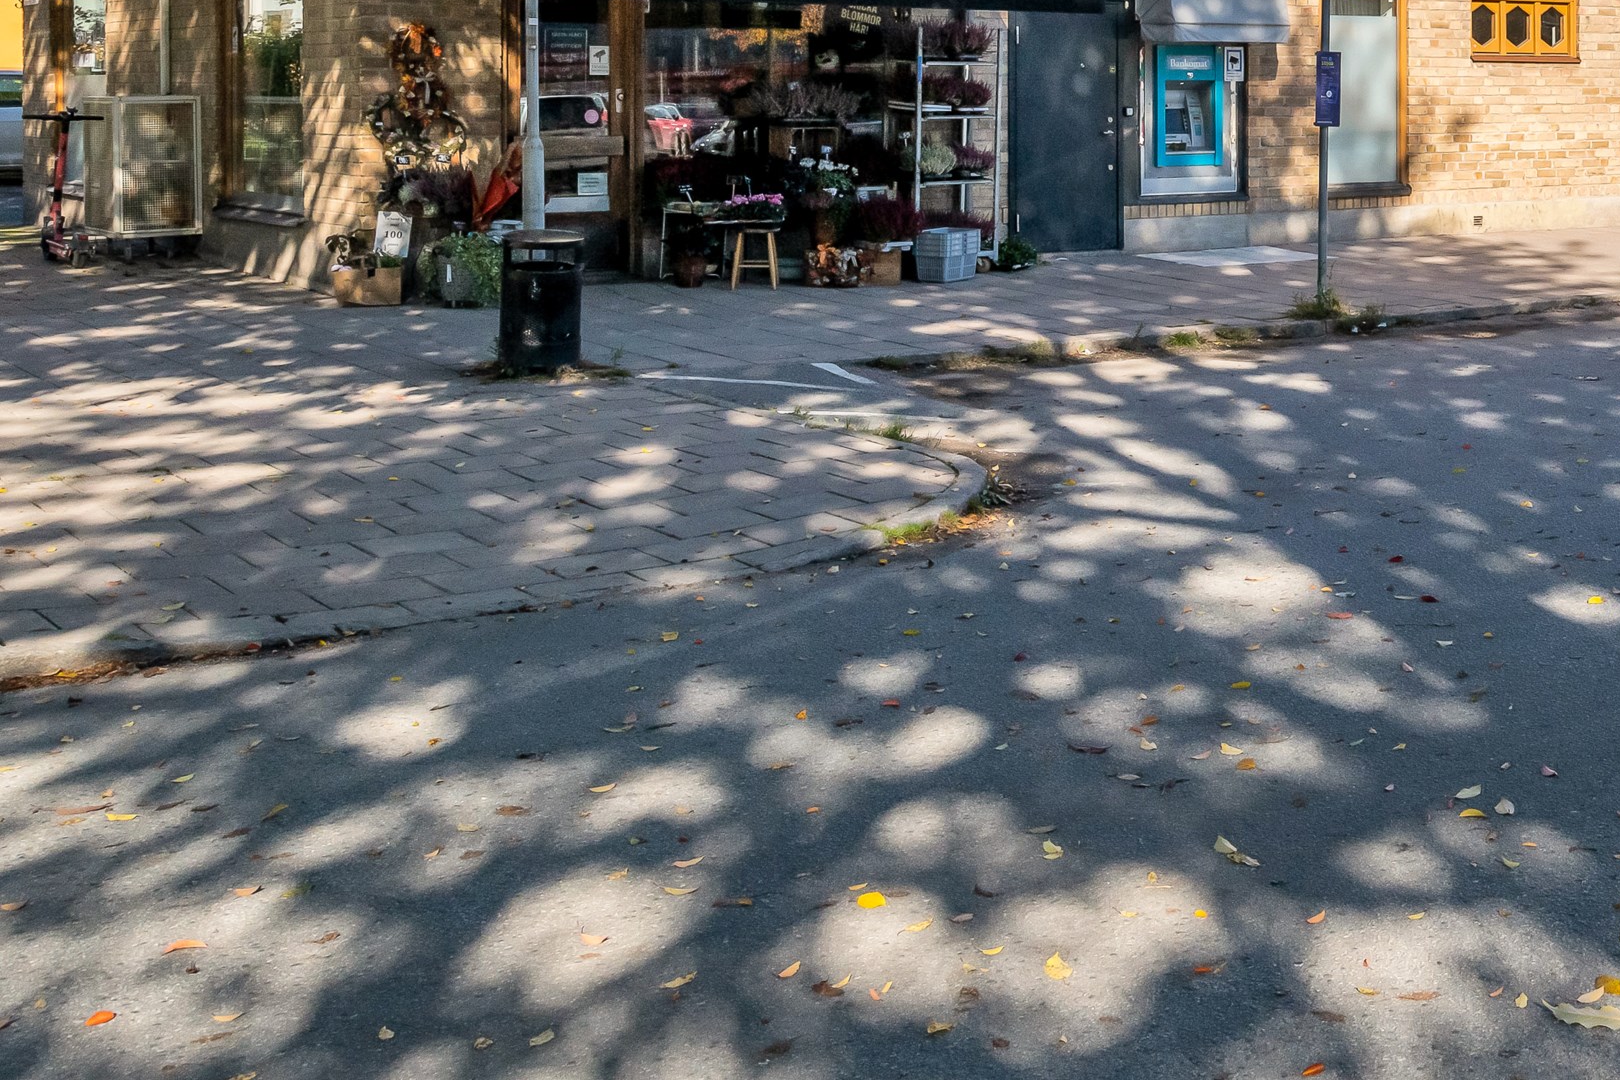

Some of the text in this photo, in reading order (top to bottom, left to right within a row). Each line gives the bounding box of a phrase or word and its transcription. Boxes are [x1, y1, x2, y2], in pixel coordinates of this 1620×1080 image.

[840, 8, 882, 26] BLOMMOR
[849, 22, 869, 35] HAR!
[1170, 58, 1208, 68] Bankomat
[384, 230, 403, 239] 100
